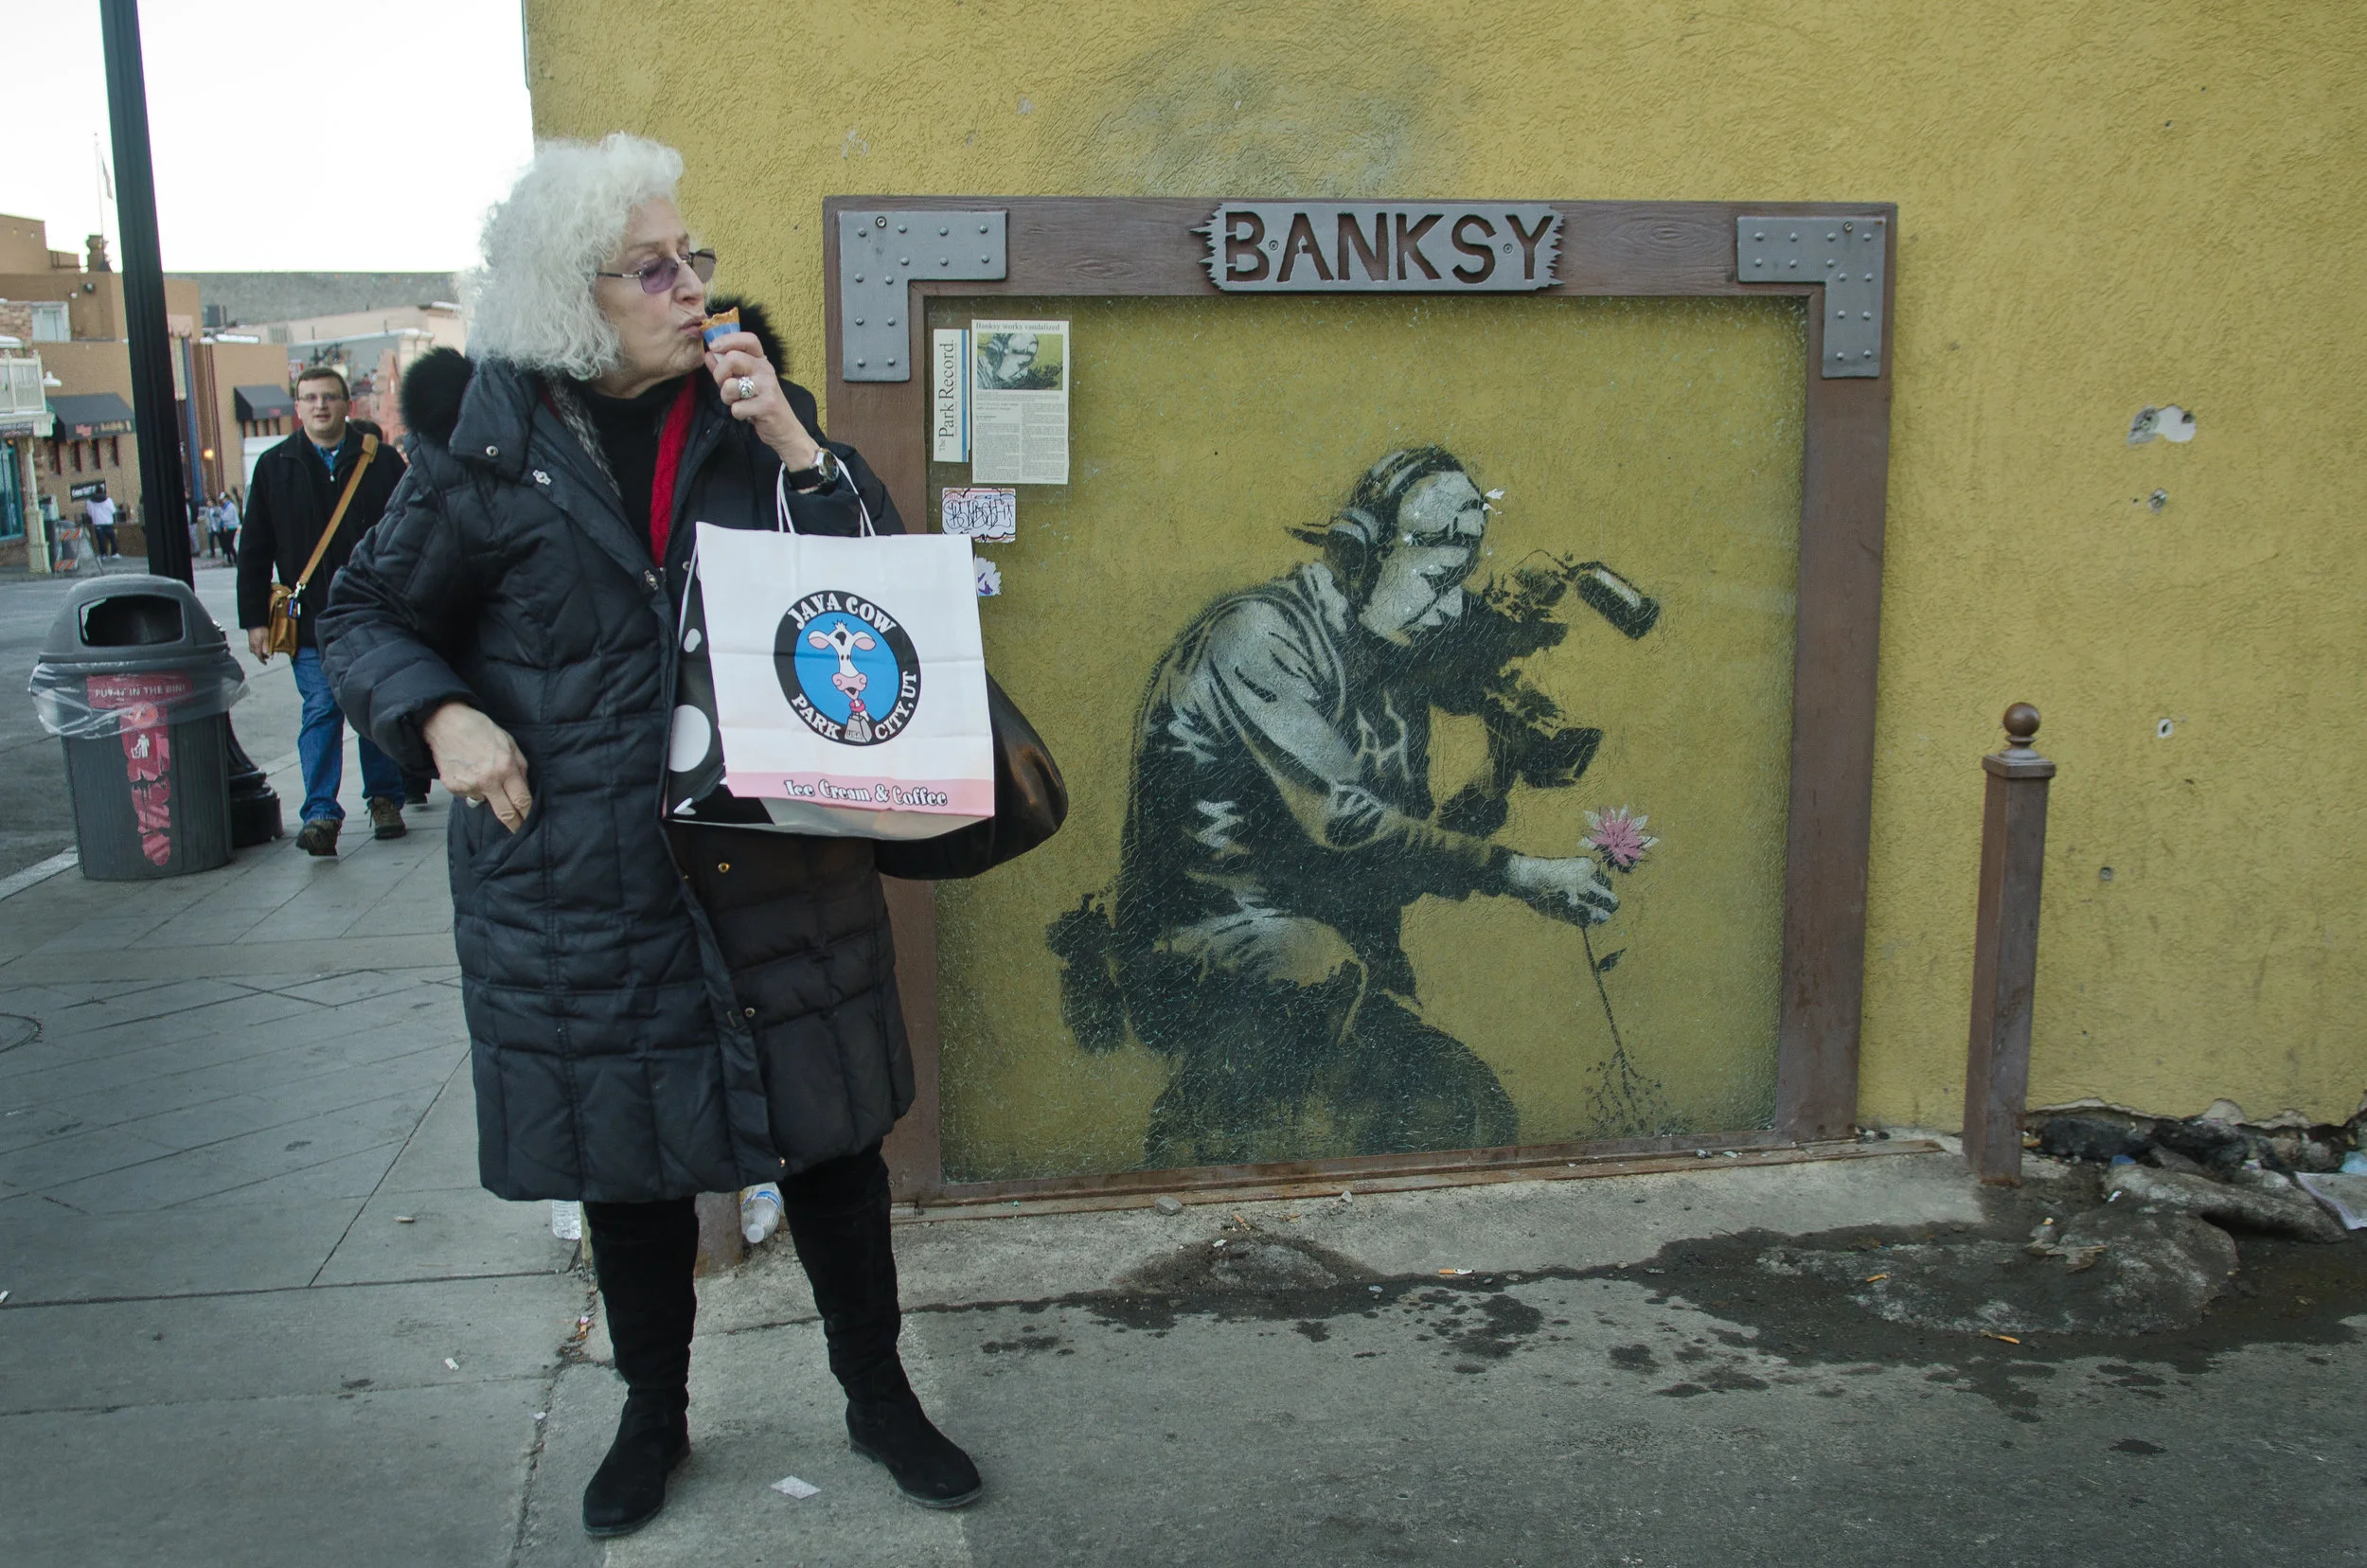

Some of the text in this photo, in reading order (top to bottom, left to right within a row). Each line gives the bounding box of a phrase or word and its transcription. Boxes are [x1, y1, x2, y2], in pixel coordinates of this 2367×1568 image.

[1225, 211, 1554, 284] BANKSY
[976, 322, 1000, 330] Banksy
[938, 402, 954, 437] Park
[788, 592, 897, 633] JAVA COW
[129, 686, 140, 697] IN
[143, 685, 163, 696] THE
[792, 694, 842, 739] PARK
[900, 670, 917, 699] UT
[784, 778, 948, 806] Ice Cream & Coffee
